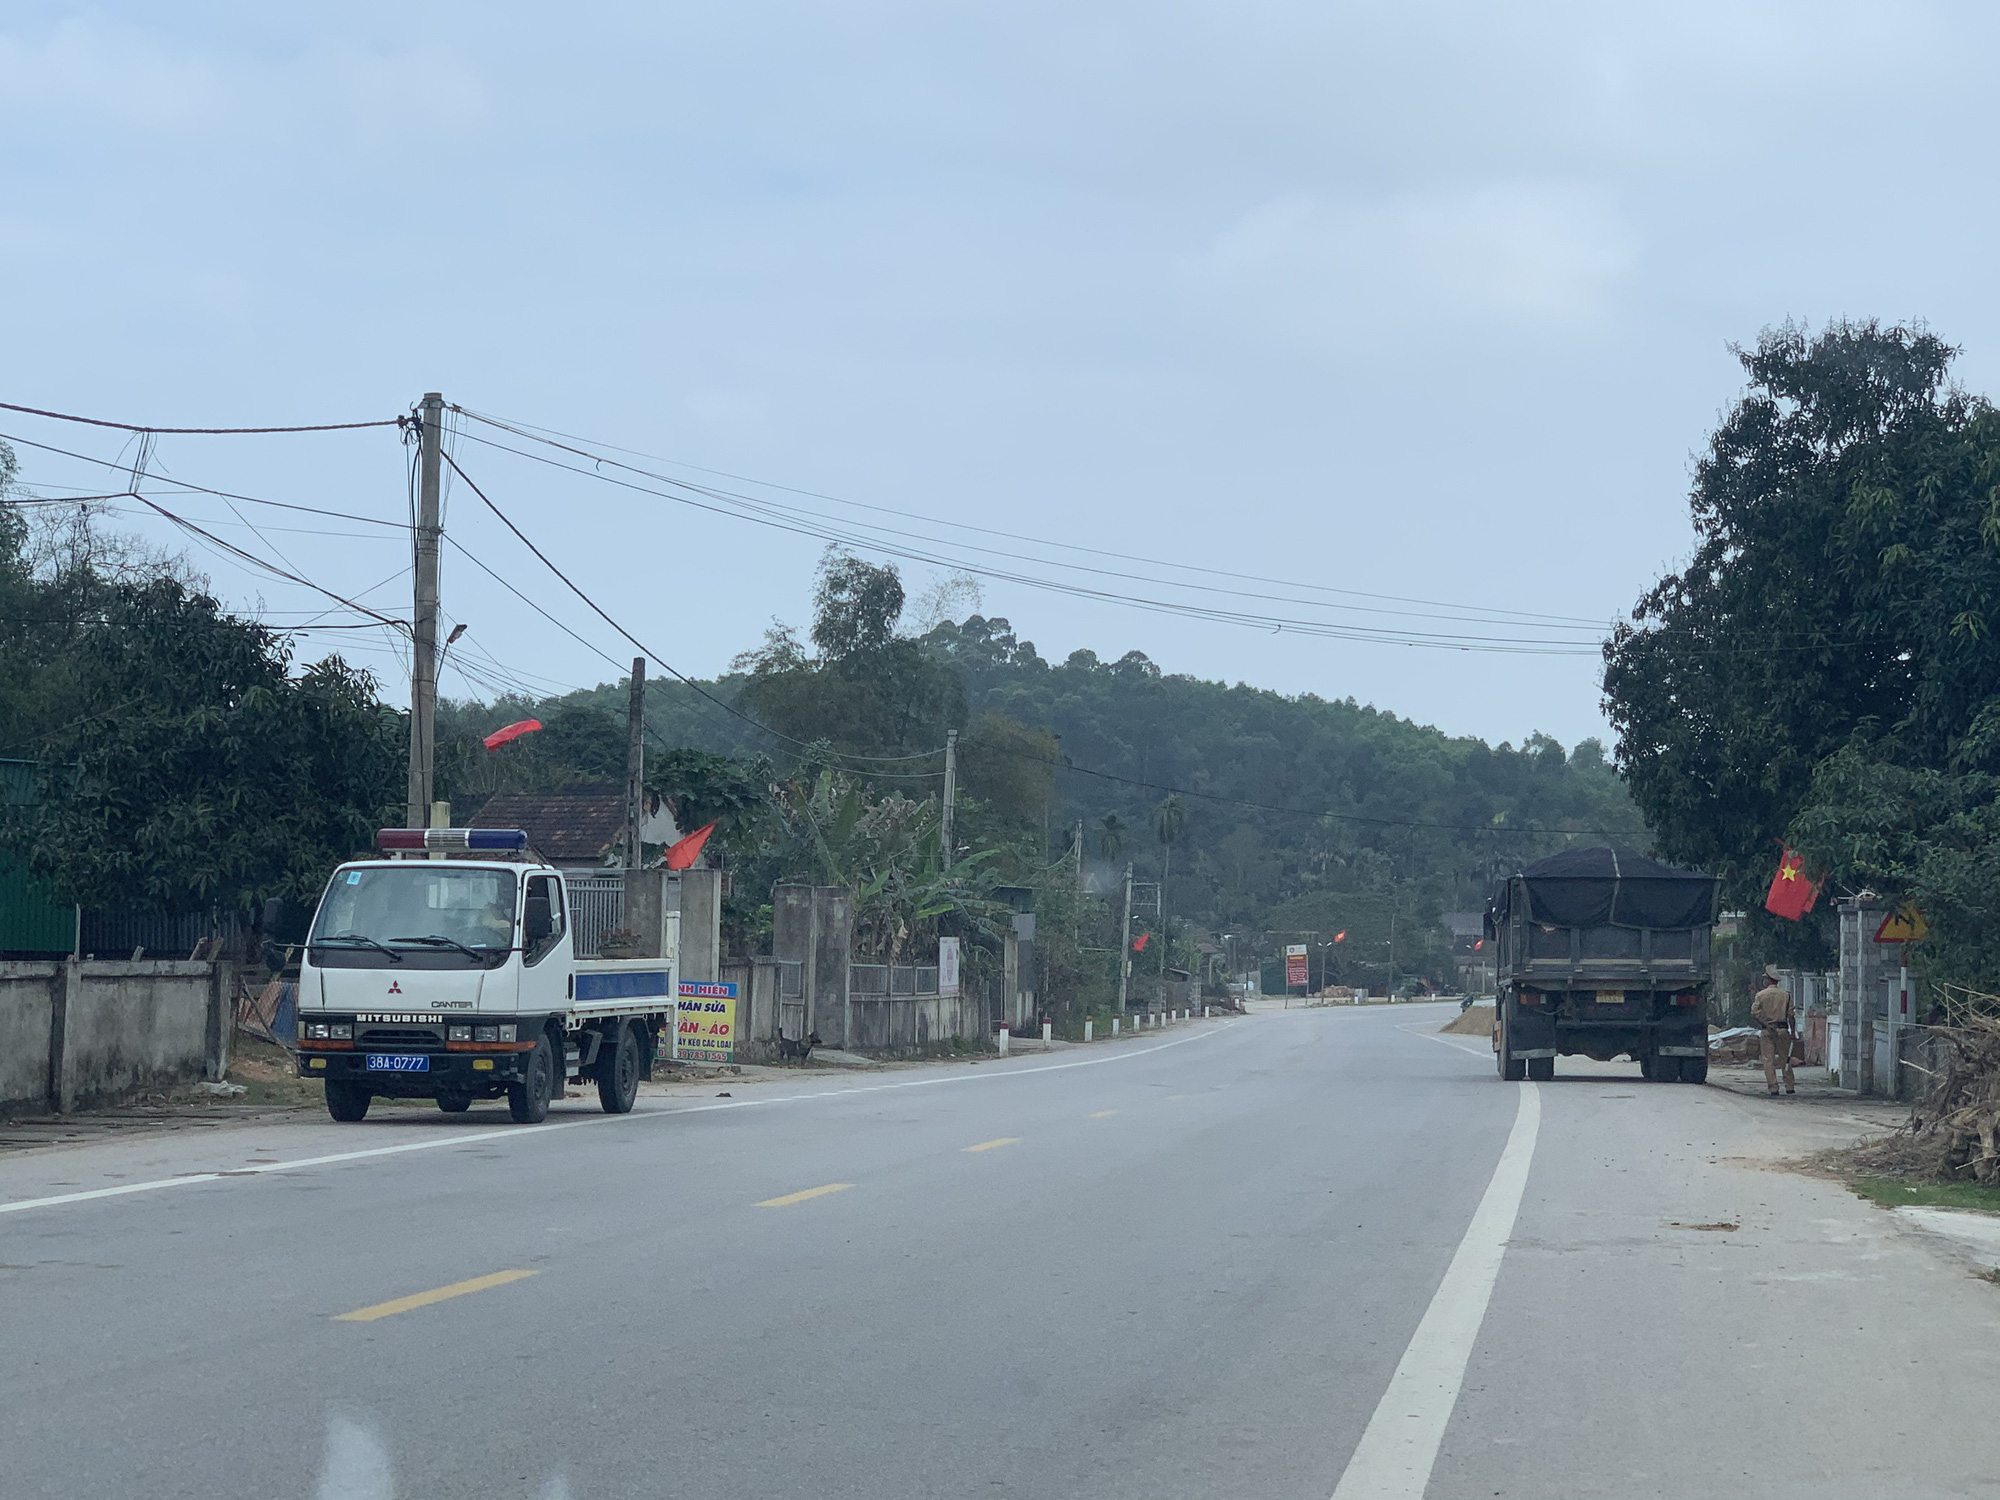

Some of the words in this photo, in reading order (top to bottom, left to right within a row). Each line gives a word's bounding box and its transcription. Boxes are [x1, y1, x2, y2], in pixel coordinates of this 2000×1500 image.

[678, 985, 694, 993] NH
[678, 1000, 702, 1013] HẬN
[704, 1000, 726, 1013] SỬA
[356, 1014, 443, 1023] MITSUBISHI
[708, 1021, 730, 1035] ÁO
[689, 1051, 705, 1060] 785
